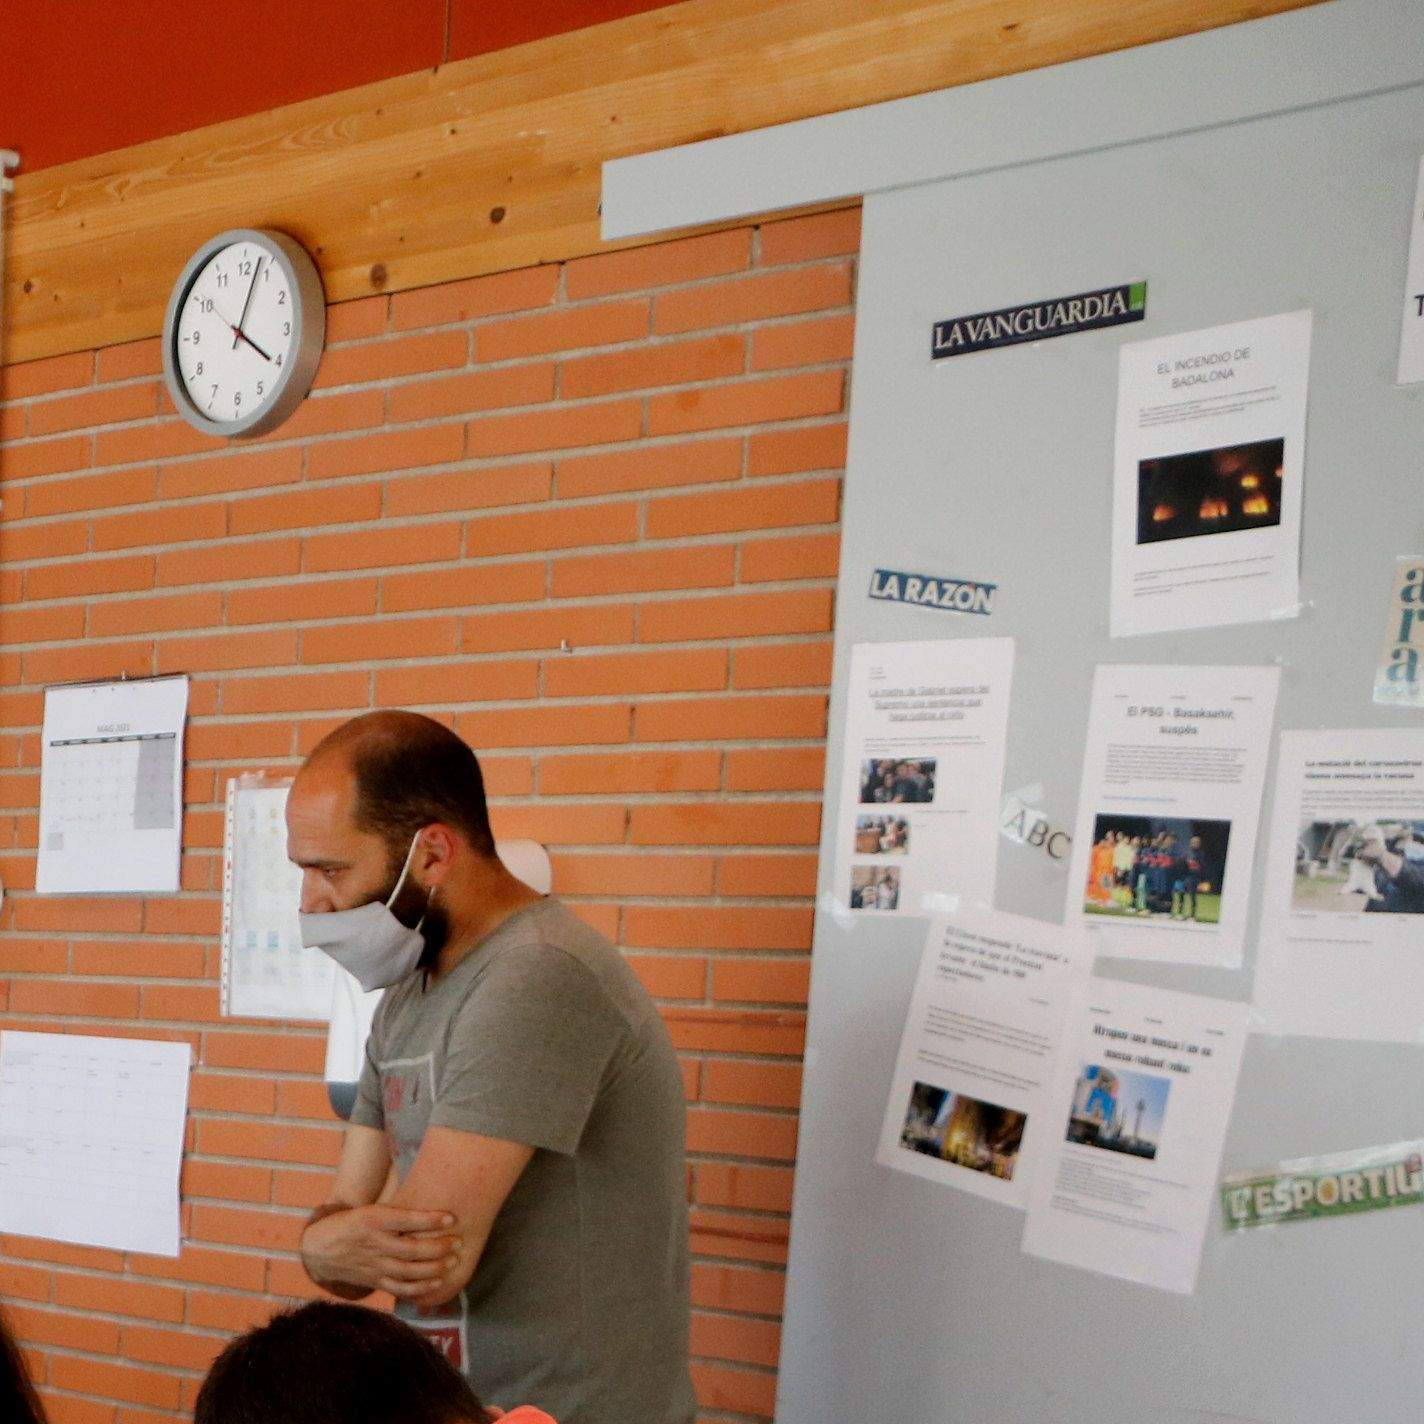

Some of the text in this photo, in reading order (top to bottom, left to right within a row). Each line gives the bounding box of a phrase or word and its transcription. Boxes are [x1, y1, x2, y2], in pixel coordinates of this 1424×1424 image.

[238, 261, 251, 276] 12
[263, 269, 270, 283] 1
[217, 273, 228, 288] 11
[278, 290, 285, 305] 2
[200, 298, 214, 314] 10
[935, 290, 1128, 349] LA VANGUARDIA
[284, 321, 291, 337] 3
[192, 331, 201, 346] 9
[275, 354, 283, 367] 4
[1156, 347, 1251, 375] EL INCENDIO DE
[195, 362, 204, 376] 8
[1171, 368, 1235, 389] BADALONA
[212, 383, 219, 398] 7
[256, 380, 264, 395] 5
[234, 391, 241, 406] 6
[871, 572, 901, 600] LA
[1003, 807, 1072, 860] ABC
